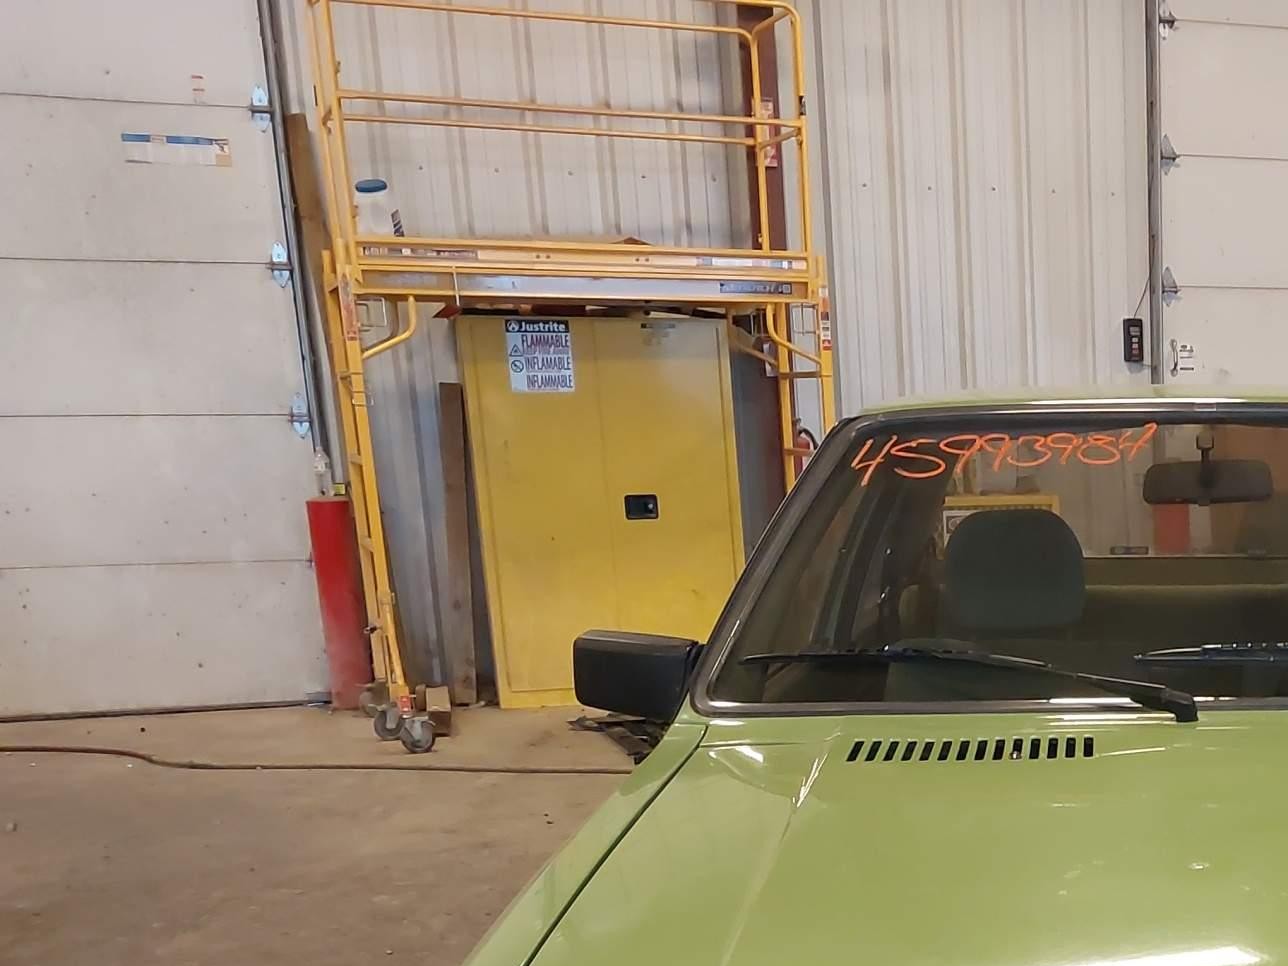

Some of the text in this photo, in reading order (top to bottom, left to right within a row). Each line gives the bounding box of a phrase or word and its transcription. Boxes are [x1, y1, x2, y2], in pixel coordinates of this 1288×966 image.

[520, 321, 566, 332] Justrite
[521, 334, 570, 348] FLAMMABLE
[527, 374, 573, 389] INFLAMMABLE
